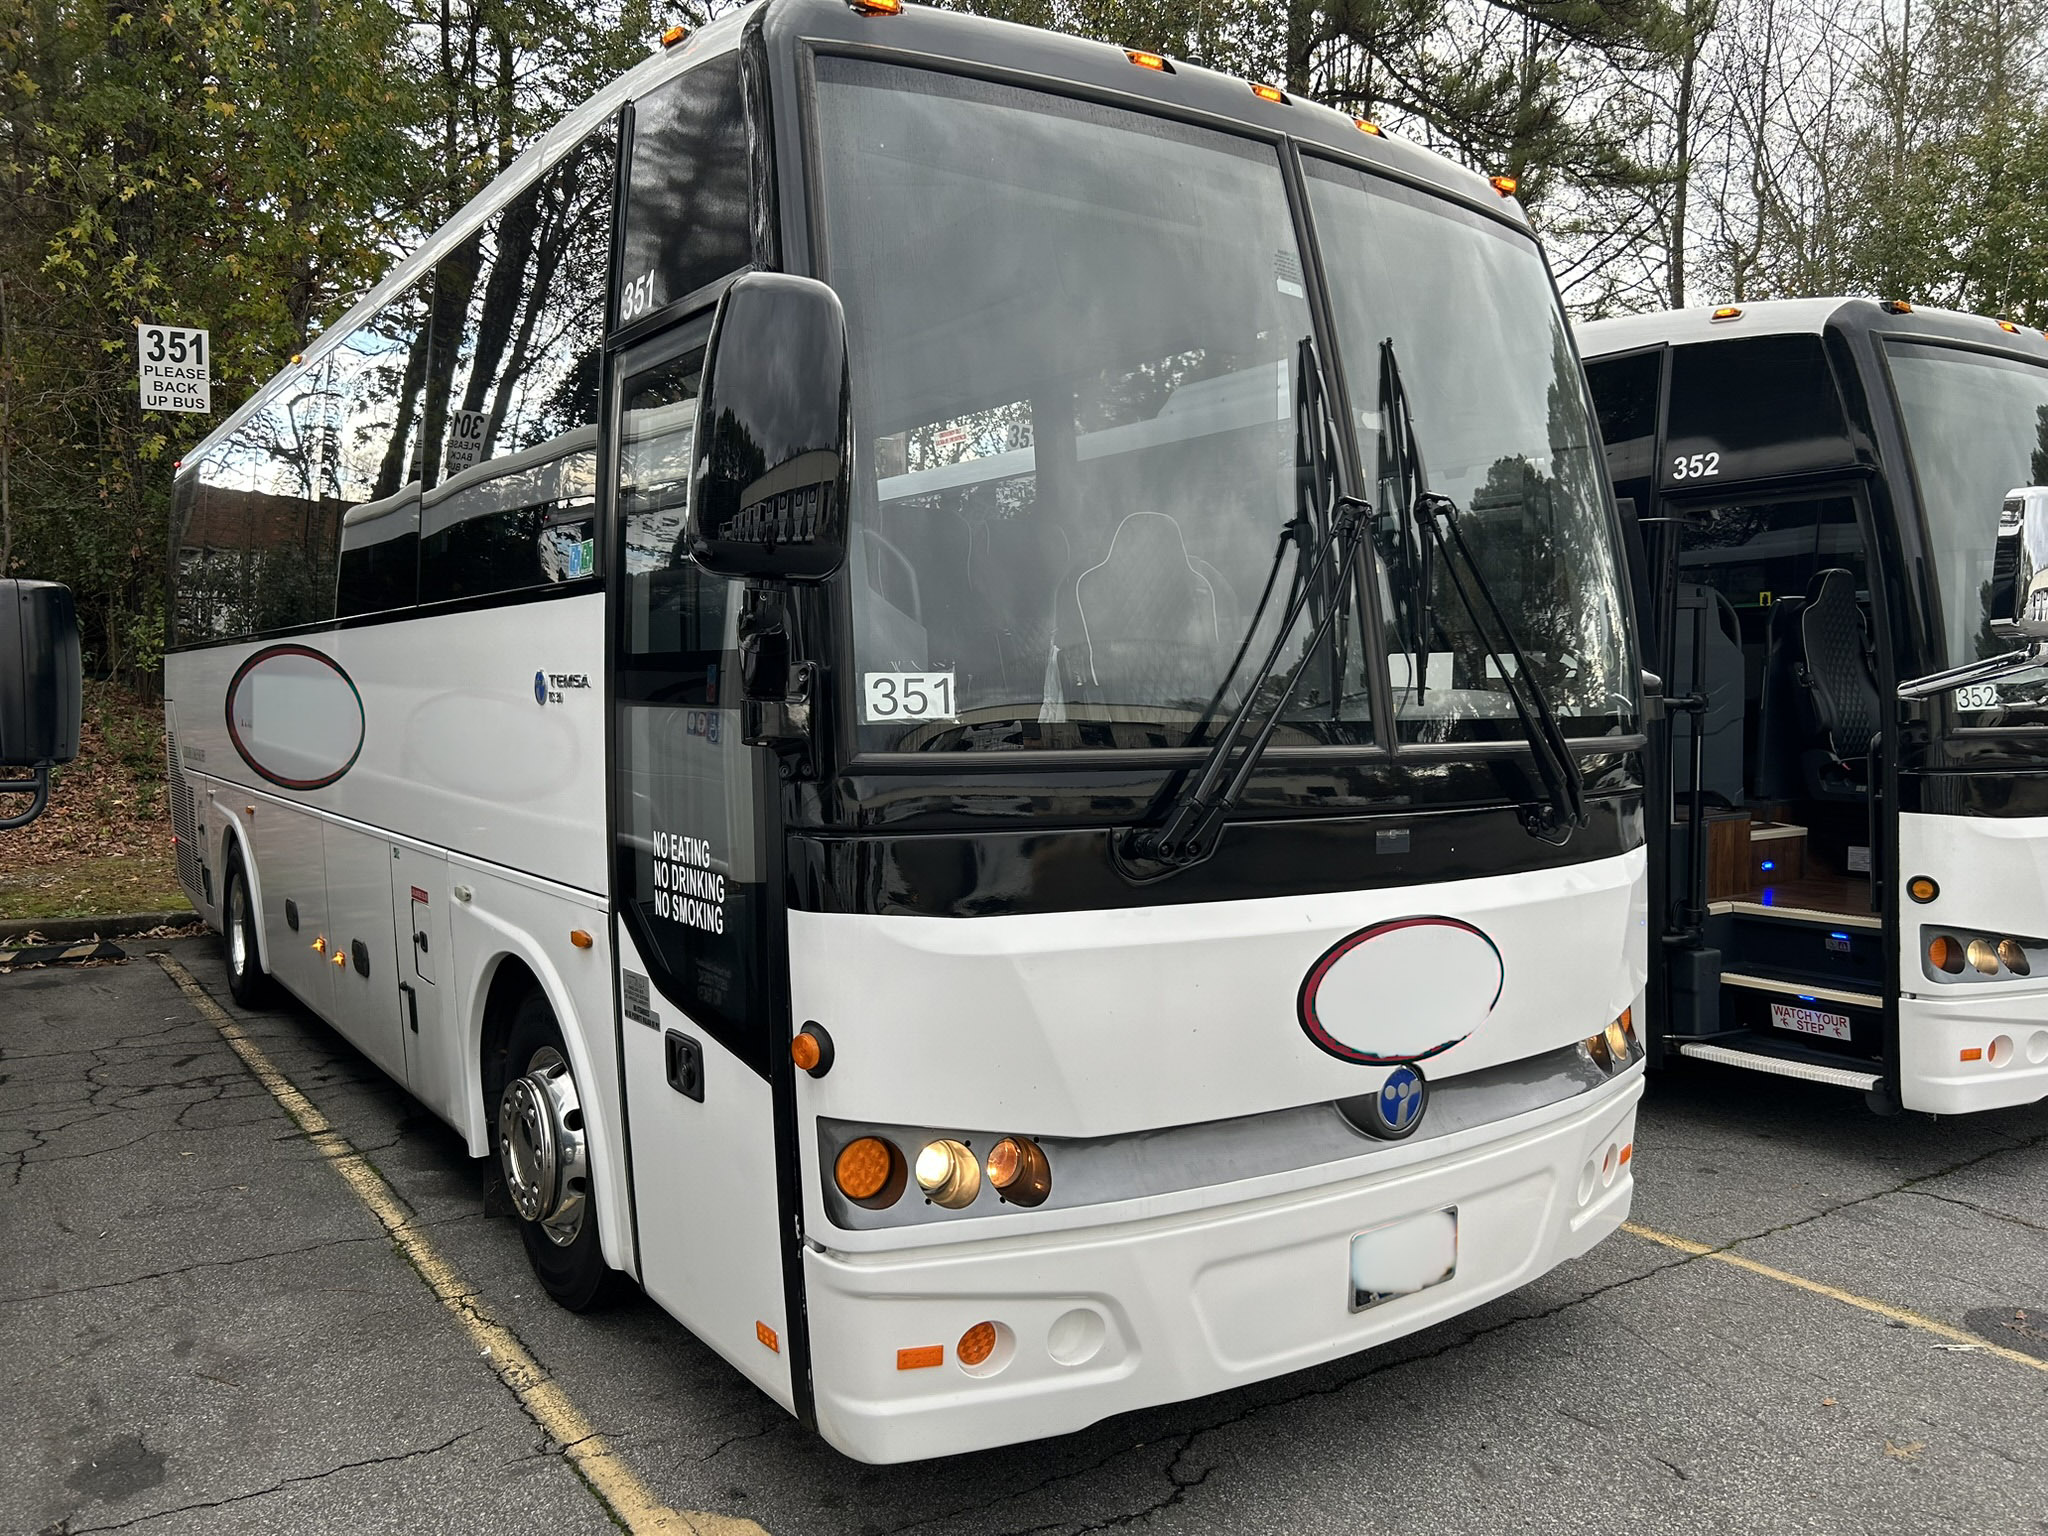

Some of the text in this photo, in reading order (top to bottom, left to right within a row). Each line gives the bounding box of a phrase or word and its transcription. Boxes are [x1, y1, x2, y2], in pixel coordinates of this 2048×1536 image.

[623, 269, 655, 320] 351
[146, 330, 204, 365] 351
[144, 365, 206, 380] PLEASE
[153, 381, 198, 394] BACK
[147, 395, 205, 409] UP BUS
[1009, 425, 1033, 449] 35
[1672, 452, 1720, 480] 352
[548, 674, 592, 689] TEMSA
[872, 678, 950, 716] 351
[1958, 686, 1997, 708] 352
[653, 830, 710, 868] NO EATING
[654, 860, 725, 903] NO DRINKING
[655, 890, 723, 934] NO SMOKING
[1773, 1005, 1847, 1028] WATCH YOUR
[1797, 1020, 1824, 1033] STEP
